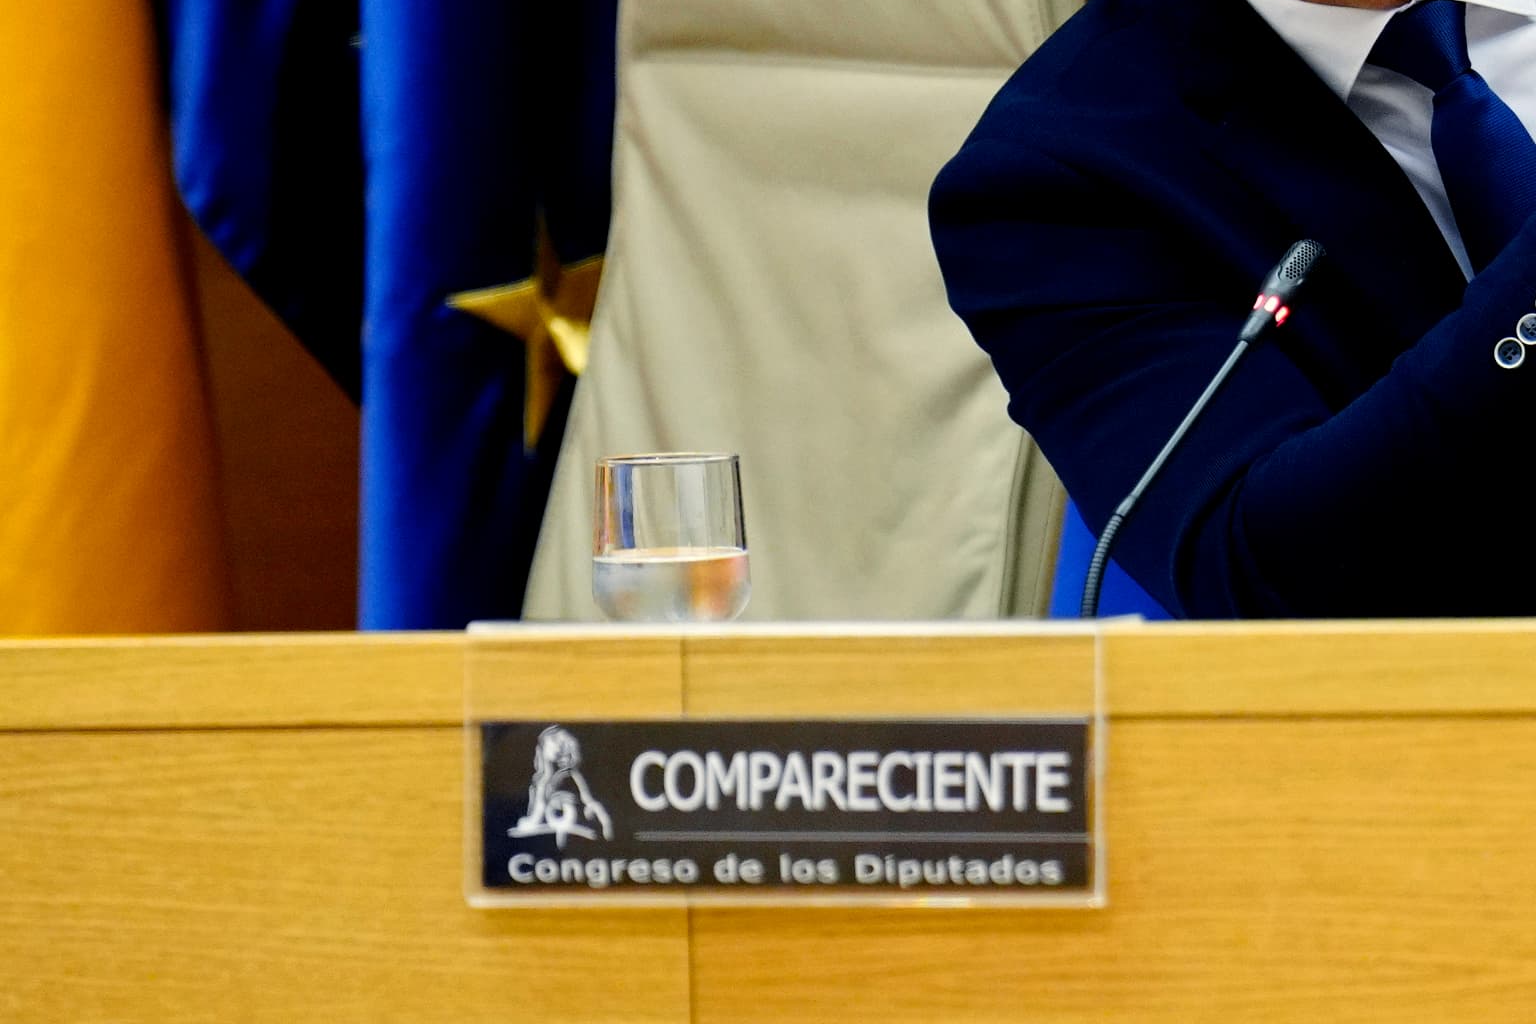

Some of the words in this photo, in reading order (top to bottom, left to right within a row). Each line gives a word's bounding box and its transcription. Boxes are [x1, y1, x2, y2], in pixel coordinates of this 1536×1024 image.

[629, 749, 1072, 813] COMPARECIENTE
[507, 852, 700, 888] Congreso
[713, 853, 763, 885] de
[779, 852, 836, 885] los
[854, 852, 1066, 888] Diputados
